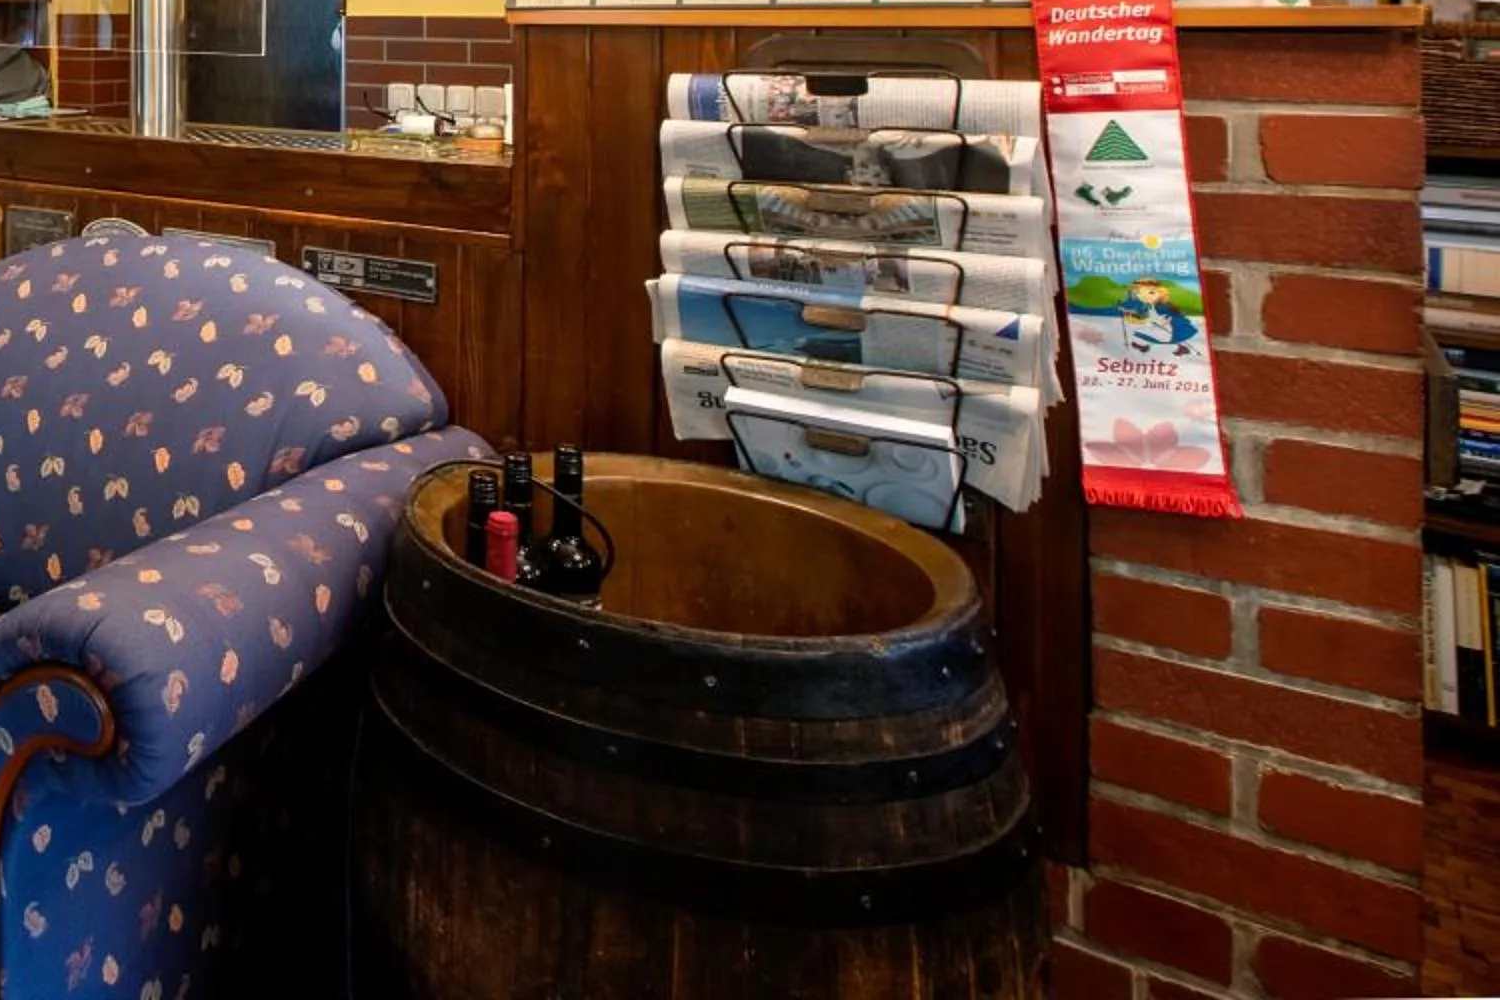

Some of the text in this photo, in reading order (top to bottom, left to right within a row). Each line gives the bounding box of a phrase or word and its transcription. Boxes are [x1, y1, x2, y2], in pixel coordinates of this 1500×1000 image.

[1051, 2, 1154, 23] Deutscher
[1047, 25, 1163, 45] Wandertag
[1072, 258, 1190, 275] Wandertag
[1096, 357, 1179, 377] Sebnitz
[1143, 378, 1170, 391] Juni
[1175, 380, 1209, 394] 2016
